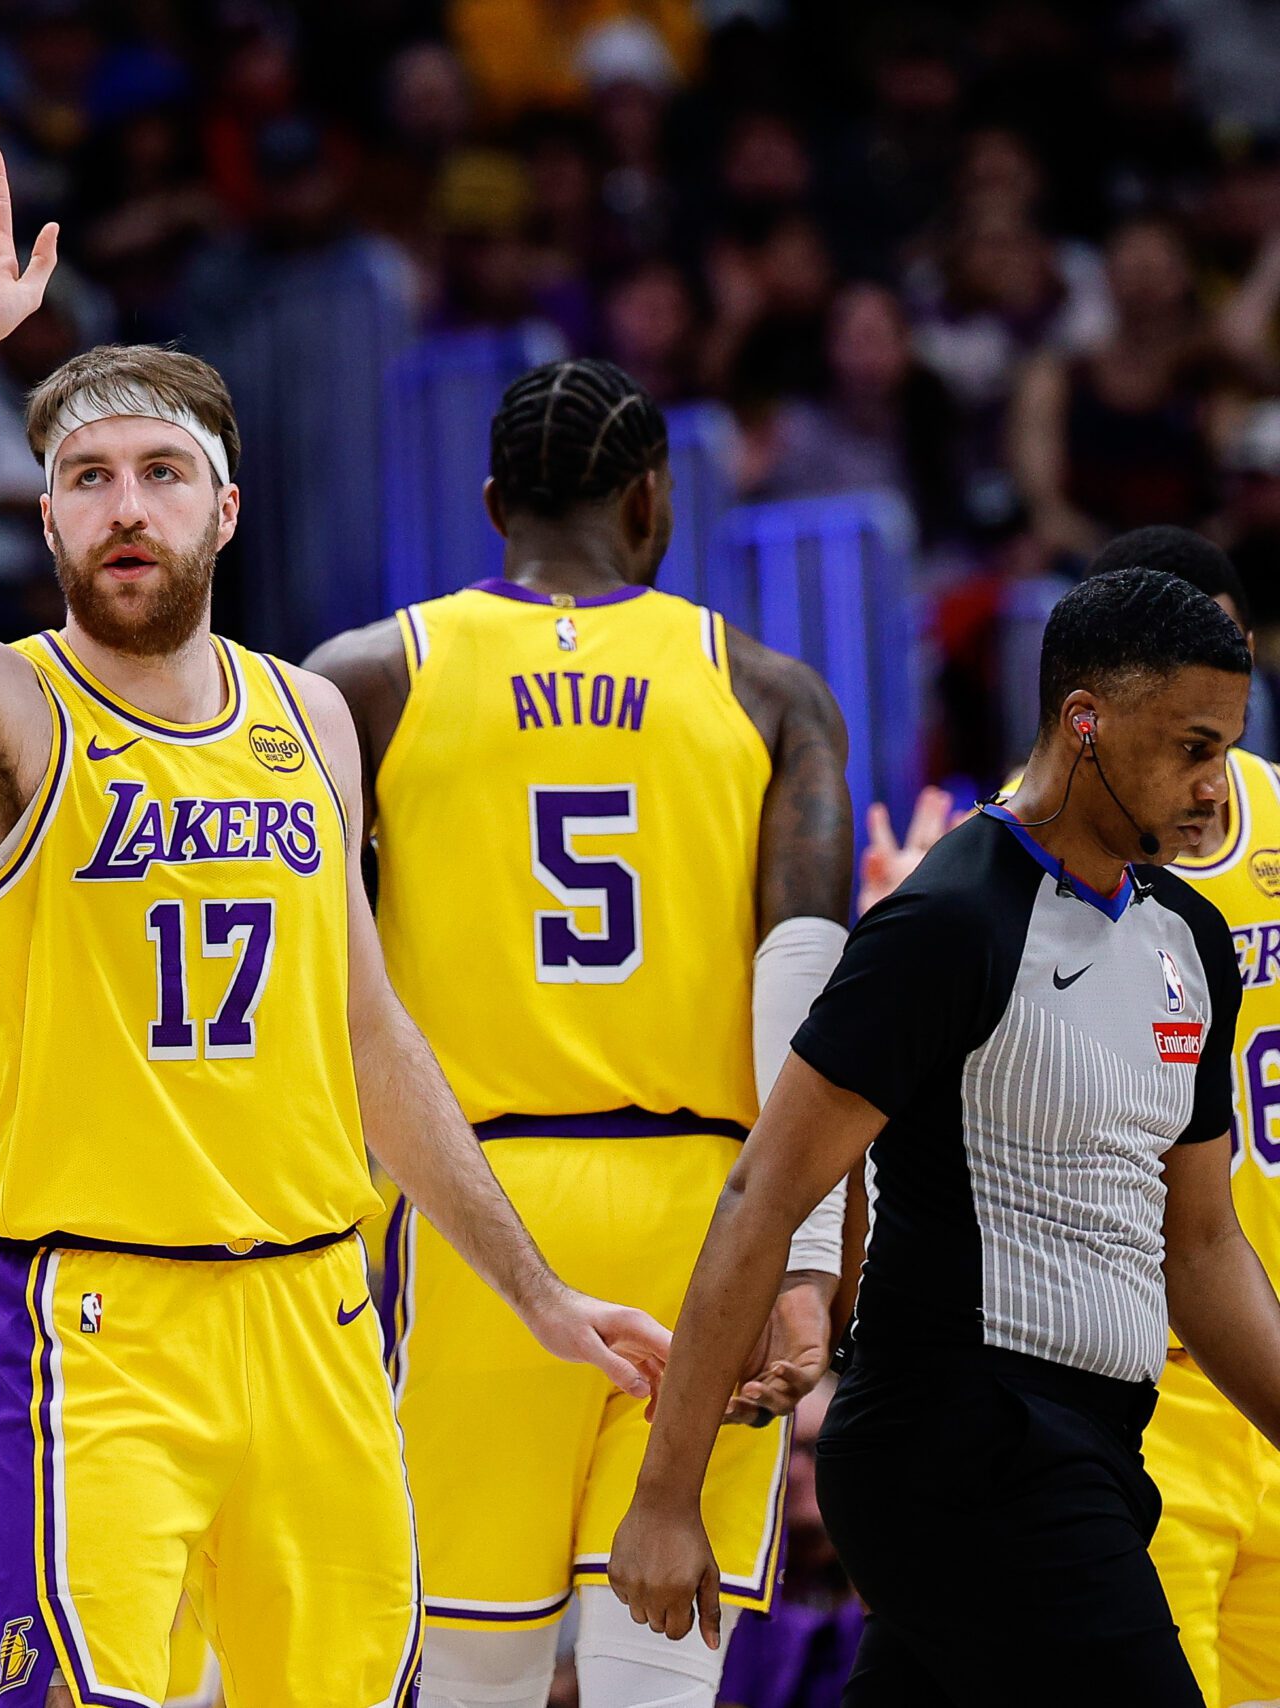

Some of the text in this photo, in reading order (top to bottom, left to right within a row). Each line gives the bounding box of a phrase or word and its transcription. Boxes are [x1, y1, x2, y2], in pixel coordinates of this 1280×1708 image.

[511, 671, 650, 732] AYTON
[251, 736, 300, 759] bibigo
[71, 780, 324, 883] LAKERS
[528, 783, 644, 984] 5
[146, 898, 277, 1062] 17
[1154, 1030, 1200, 1054] Emirates
